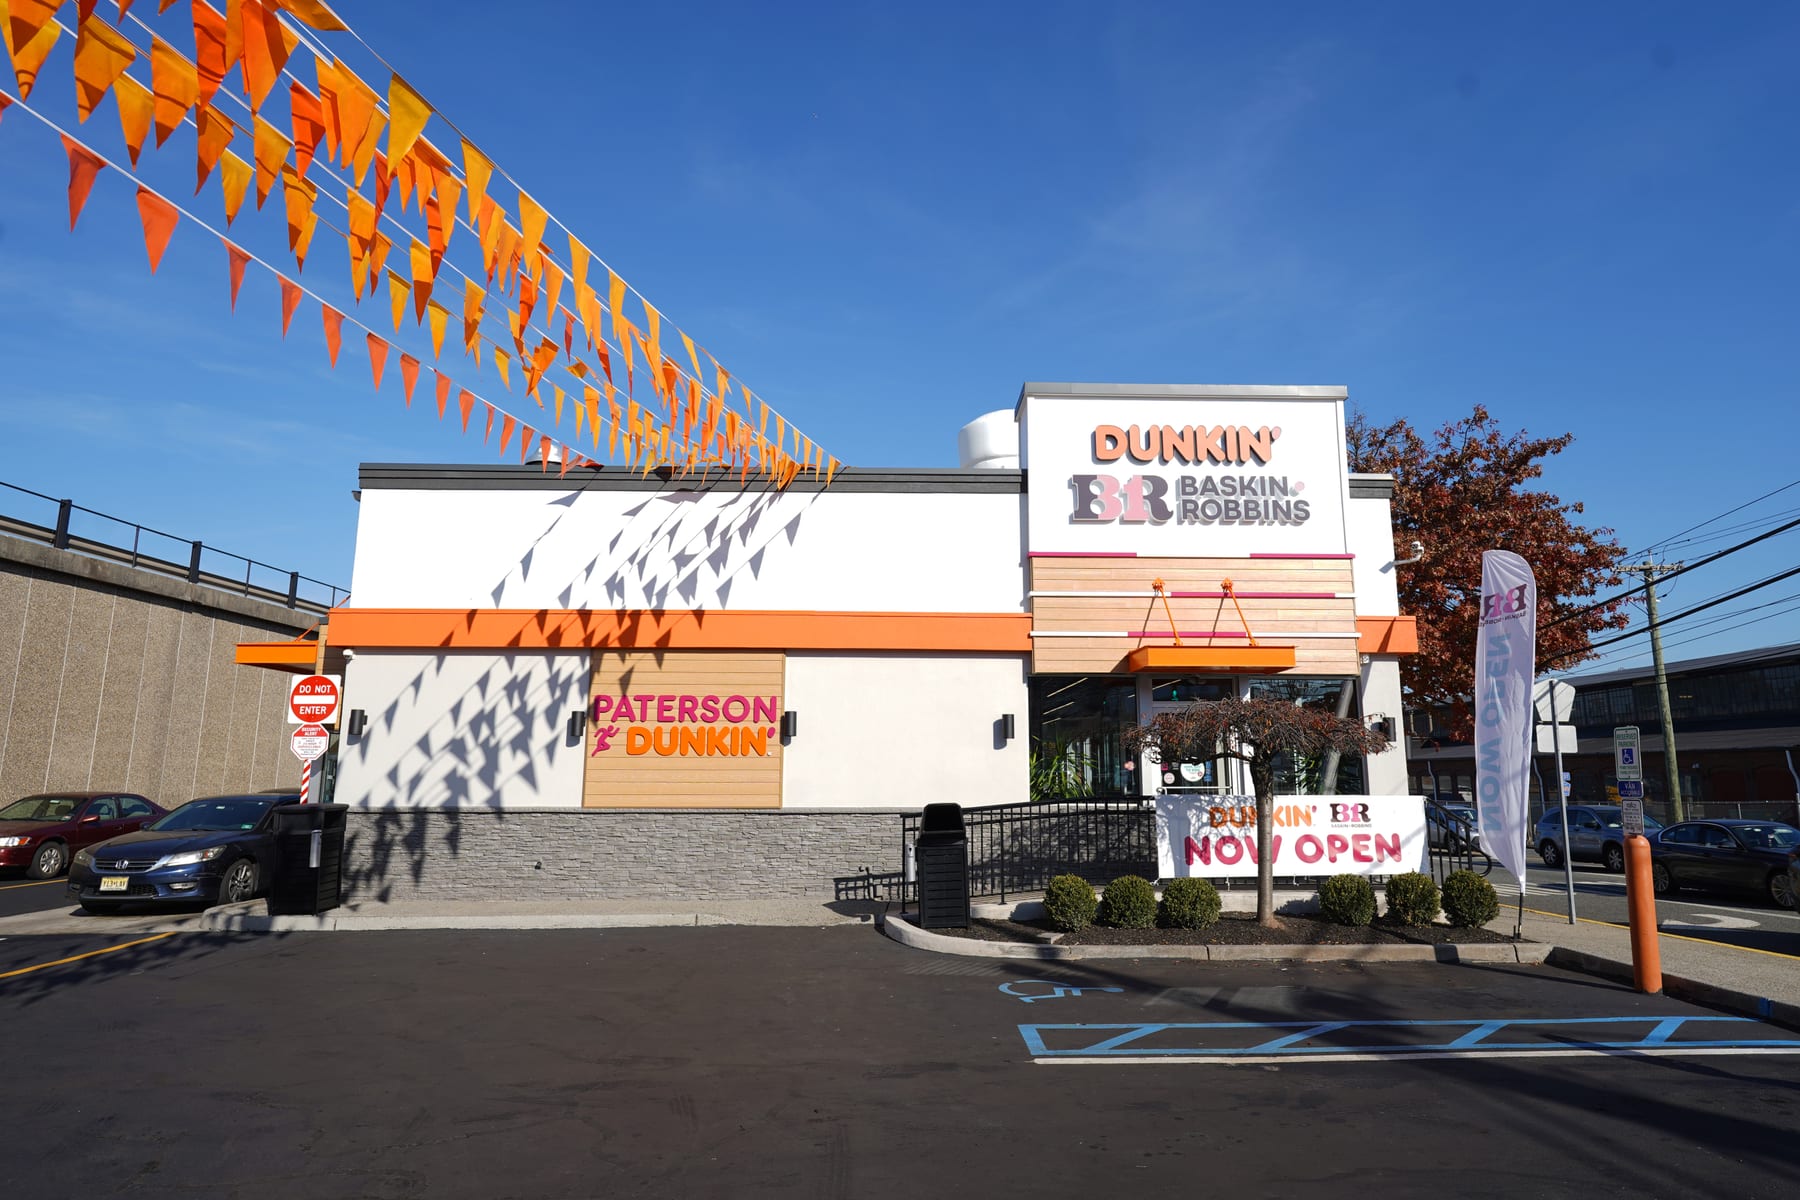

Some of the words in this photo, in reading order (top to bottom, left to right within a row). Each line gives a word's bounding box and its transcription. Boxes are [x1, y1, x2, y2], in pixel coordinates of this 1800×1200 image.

[1094, 424, 1282, 463] DUNKIN'
[1072, 474, 1174, 521] BR
[1181, 499, 1311, 521] ROBBINS
[299, 685, 311, 694] DO
[314, 685, 332, 694] NOT
[299, 705, 327, 715] ENTER
[593, 694, 777, 724] PATERSON
[626, 725, 776, 757] DUNKIN'
[1329, 803, 1371, 822] BR
[1184, 833, 1283, 866] NOW
[1294, 832, 1402, 864] OPEN
